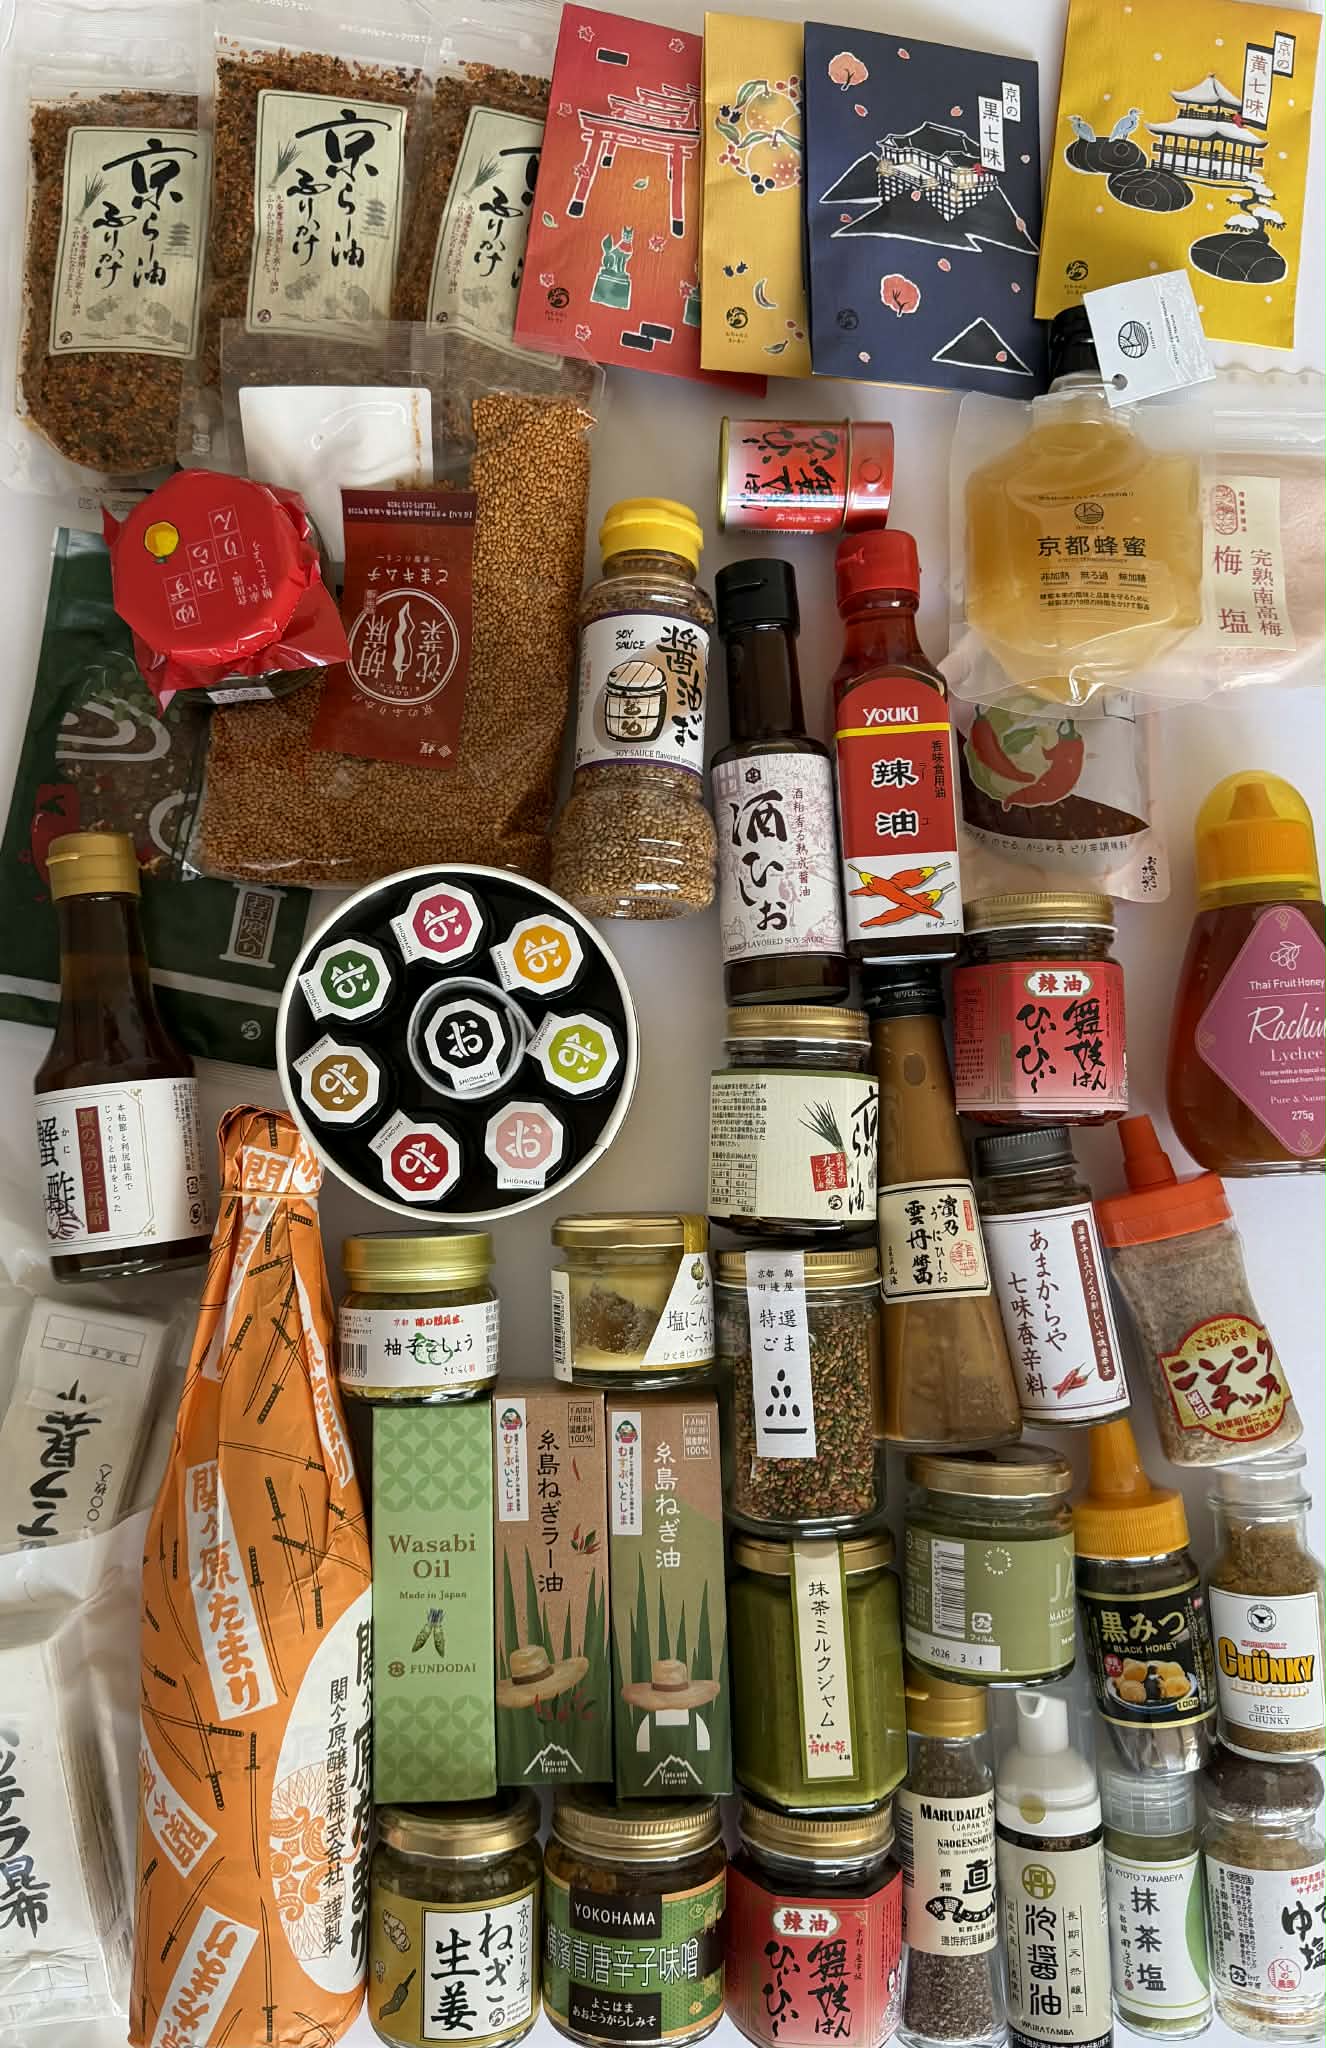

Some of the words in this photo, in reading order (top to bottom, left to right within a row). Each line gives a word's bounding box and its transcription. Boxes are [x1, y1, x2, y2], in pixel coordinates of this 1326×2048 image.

[1276, 39, 1294, 71] 京の
[1245, 54, 1269, 120] 黄七味
[1003, 86, 1019, 119] 京の
[982, 100, 1003, 167] 黒七味
[286, 167, 332, 267] ふりかけ
[473, 185, 524, 277] ふりかけ
[92, 200, 137, 290] ふりかけ
[1037, 535, 1147, 558] 京都蜂蜜
[367, 566, 450, 585] ごまキムチ
[1213, 544, 1252, 634] 梅塩
[1249, 548, 1285, 638] 完熟南高梅
[615, 629, 634, 640] SOY
[615, 641, 647, 651] SAUCE
[357, 615, 392, 679] 胡麻
[415, 619, 447, 684] 沈菜
[931, 740, 947, 800] 香味食用油
[872, 757, 920, 838] 辣油
[784, 936, 801, 946] SOY
[1037, 973, 1083, 994] 辣油
[1248, 980, 1271, 992] Thai
[1272, 978, 1296, 990] Fruit
[1297, 977, 1325, 990] Honey
[1063, 998, 1108, 1091] 舞妓はん
[1269, 1047, 1323, 1067] Lychee
[1270, 1094, 1291, 1105] Pure
[1291, 1110, 1315, 1122] 275g
[60, 1127, 71, 1154] かに
[1028, 1228, 1069, 1353] あまからや
[758, 1308, 798, 1329] 特選
[383, 1333, 474, 1357] 柚子こしょう
[762, 1335, 796, 1352] ごま
[1007, 1271, 1049, 1399] 七味香辛料
[569, 1434, 593, 1444] 100%
[685, 1446, 710, 1456] 100%
[536, 1429, 564, 1593] 糸島ねぎラー油
[653, 1441, 681, 1569] 糸島ねぎ油
[388, 1532, 477, 1554] Wasabi
[412, 1558, 451, 1579] Oil
[399, 1591, 425, 1600] Made
[426, 1591, 437, 1599] in
[438, 1590, 468, 1601] Japan
[1100, 1609, 1186, 1643] 黒みつ
[807, 1581, 836, 1728] 抹茶ミルクジャム
[930, 1646, 951, 1659] 2026
[960, 1653, 967, 1663] 3
[1113, 1644, 1143, 1654] BLACK
[1145, 1640, 1178, 1654] HONEY
[409, 1662, 477, 1674] FUNDODAI
[1248, 1713, 1291, 1725] CHUNKY
[1253, 1702, 1284, 1714] SPICE
[919, 1802, 987, 1822] MARUDAIZU
[1115, 1867, 1140, 1882] KYOTO
[1141, 1873, 1184, 1884] TANABEYA
[574, 1902, 656, 1926] YOKOHAMA
[783, 1909, 829, 1933] 辣油
[1130, 1885, 1168, 1992] 抹茶塩
[478, 1912, 514, 2003] ねぎ
[430, 1927, 481, 2032] 生姜
[806, 1938, 852, 2039] 舞妓はん
[572, 2005, 657, 2028] あおとうがらしみそ
[591, 1996, 634, 2014] よこはま
